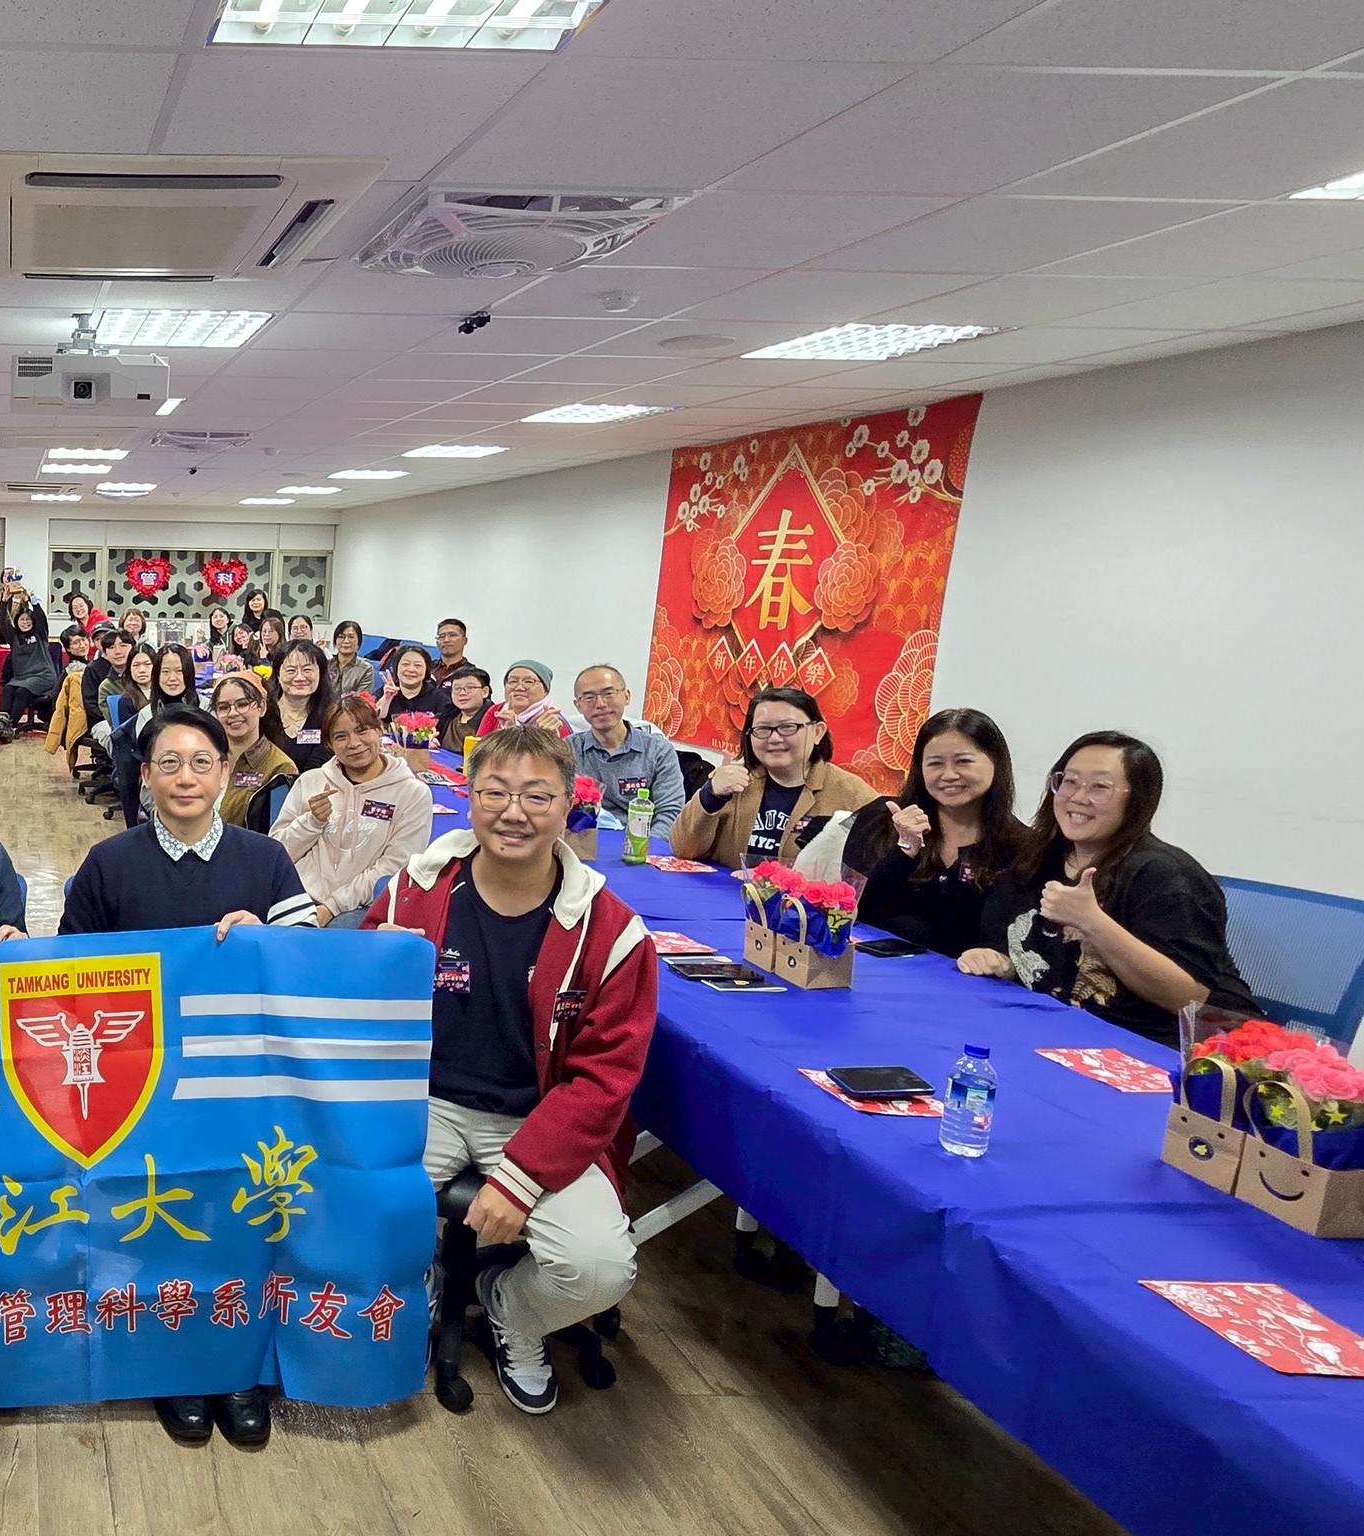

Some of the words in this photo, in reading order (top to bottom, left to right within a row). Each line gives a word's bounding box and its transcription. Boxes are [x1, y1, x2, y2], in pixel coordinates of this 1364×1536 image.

[217, 571, 234, 587] 科
[745, 509, 814, 630] 春
[713, 648, 826, 686] 新年快樂
[7, 973, 70, 994] TAMKANG
[76, 968, 151, 989] UNIVERSITY
